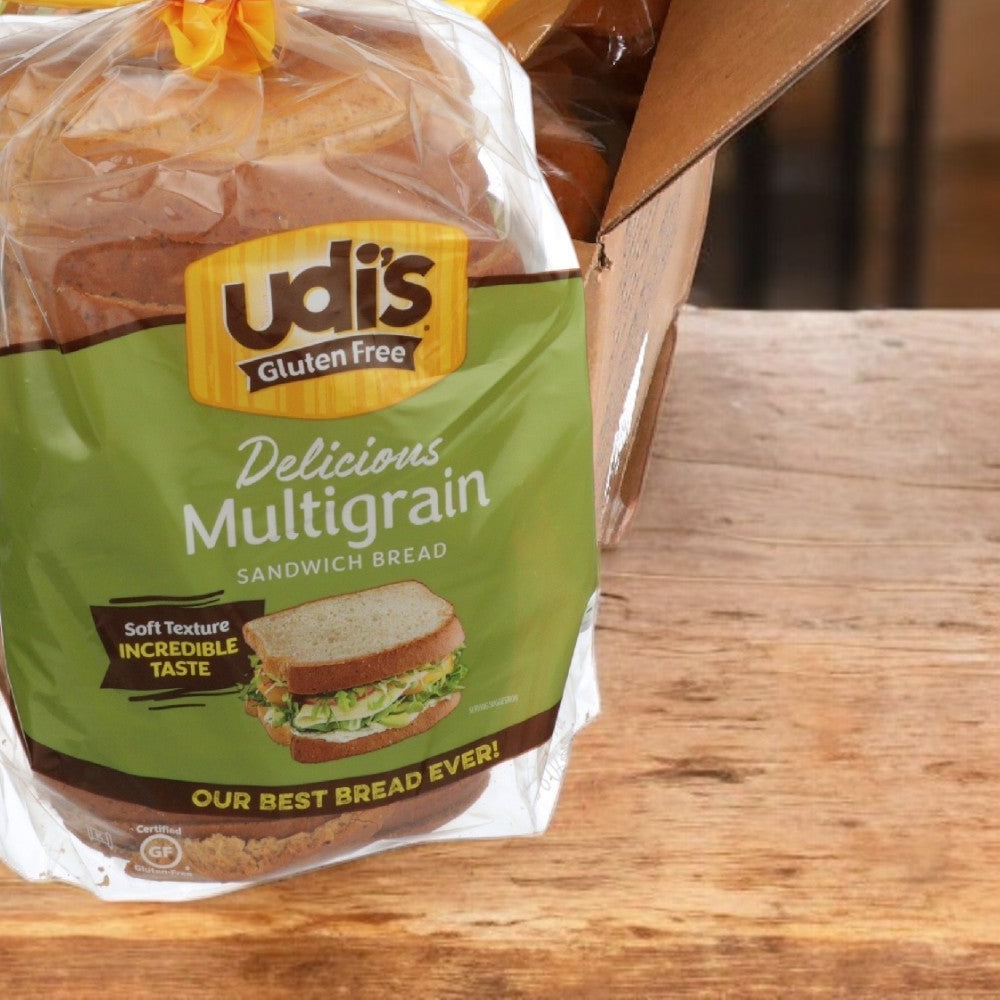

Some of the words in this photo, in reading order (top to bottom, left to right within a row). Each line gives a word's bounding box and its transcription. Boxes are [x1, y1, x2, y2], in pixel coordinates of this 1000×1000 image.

[257, 349, 347, 384] Gluten
[352, 339, 406, 365] Free
[236, 434, 443, 490] Delicious
[183, 467, 490, 556] Multigrain
[236, 553, 363, 585] SANDWICH
[372, 542, 447, 569] BREAD
[124, 620, 162, 637] Soft
[164, 620, 230, 637] Texture
[118, 637, 239, 660] INCREDIBLE
[150, 661, 211, 678] TASTE
[191, 789, 252, 811] OUR
[259, 789, 329, 811] BEST
[335, 770, 422, 807] BREAD
[428, 740, 500, 783] EVER!
[135, 824, 182, 836] Certified
[148, 845, 174, 858] GF
